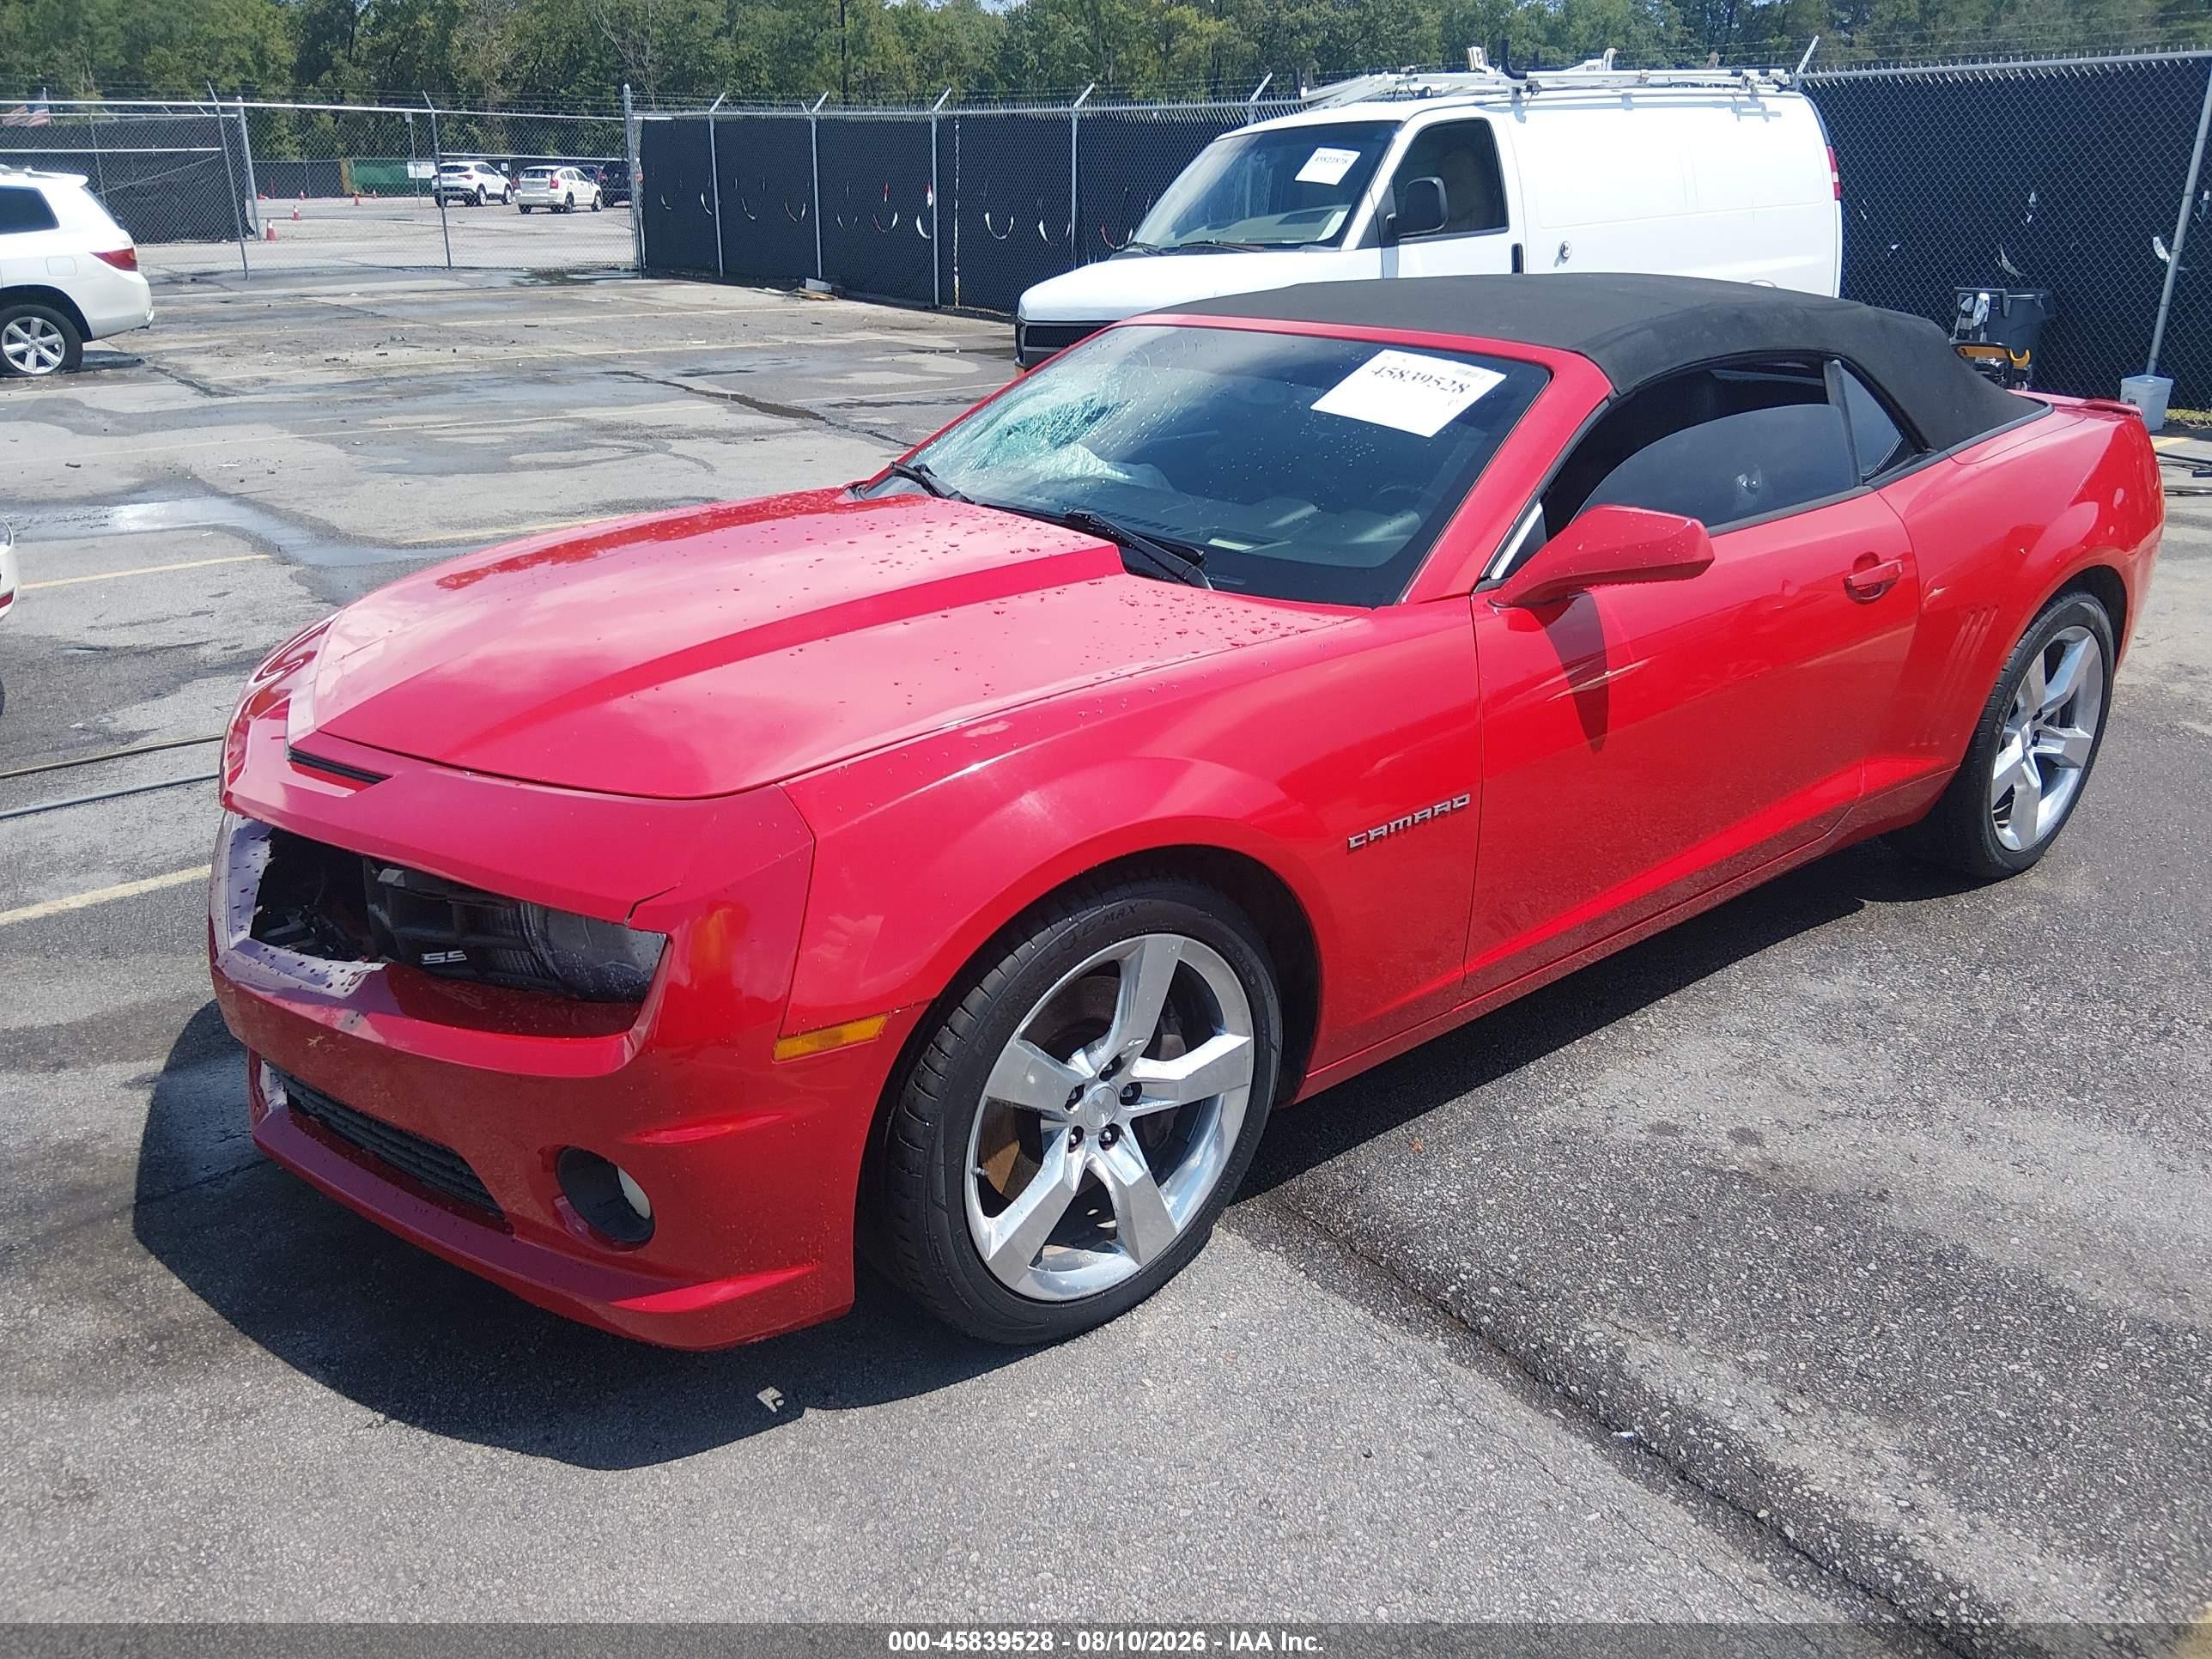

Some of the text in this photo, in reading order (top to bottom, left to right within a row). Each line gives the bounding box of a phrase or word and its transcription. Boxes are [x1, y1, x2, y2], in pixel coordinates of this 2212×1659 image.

[1371, 366, 1470, 394] 45839528
[1348, 793, 1470, 848] CAMARO
[421, 950, 467, 965] SS
